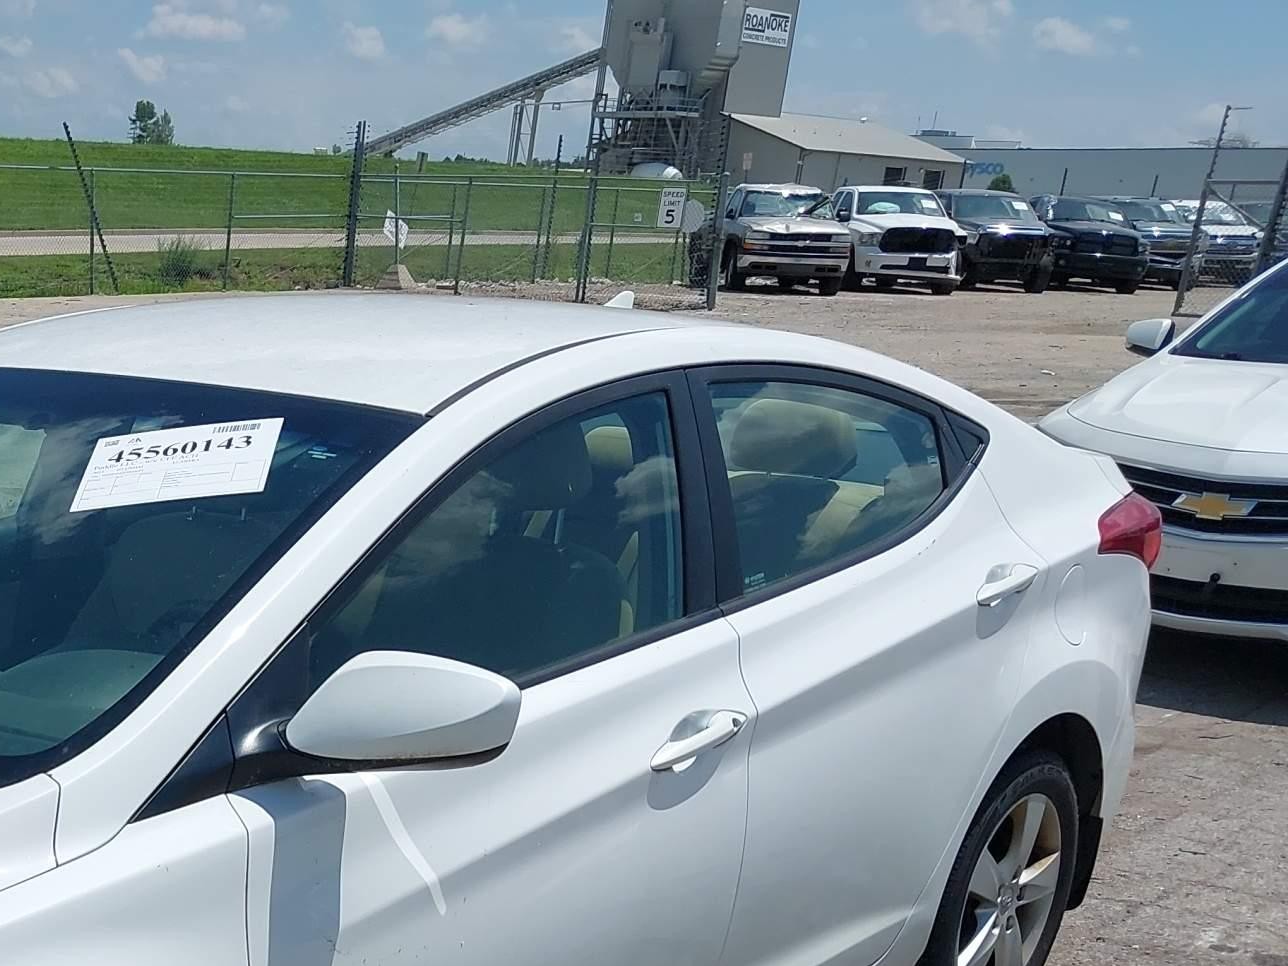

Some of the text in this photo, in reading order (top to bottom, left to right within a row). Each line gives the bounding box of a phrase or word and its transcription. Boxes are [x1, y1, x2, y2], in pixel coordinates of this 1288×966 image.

[744, 13, 790, 33] ROANOKE
[664, 209, 675, 224] 5
[108, 435, 253, 463] 45560143
